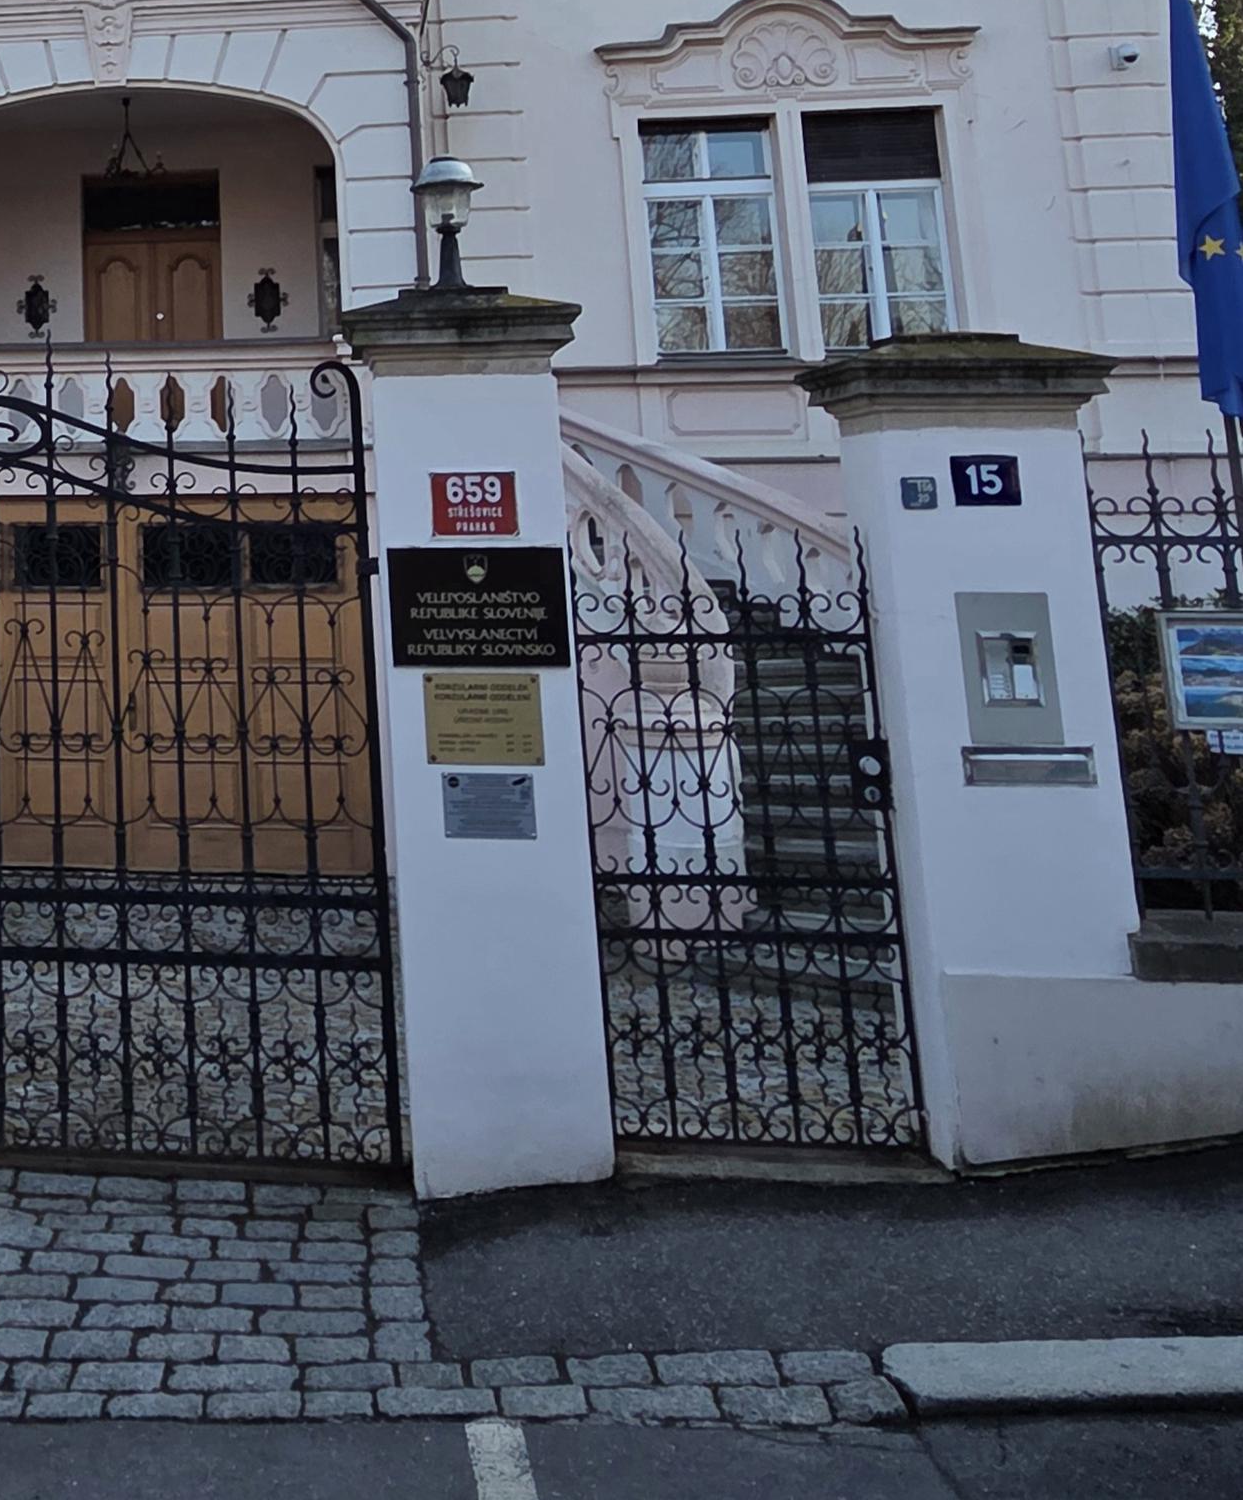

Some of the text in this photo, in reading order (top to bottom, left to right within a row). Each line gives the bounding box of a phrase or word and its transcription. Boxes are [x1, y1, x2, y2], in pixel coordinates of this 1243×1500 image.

[965, 464, 1003, 495] 15
[446, 475, 502, 504] 659
[447, 505, 503, 518] STŘEŠOVICE
[456, 521, 487, 532] PRAHA
[416, 590, 541, 604] VELEPOSLANIŠTVO
[410, 607, 548, 621] REPUBLIKE SLOVENIJE
[423, 626, 539, 641] VELVYSLANECTVÍ
[407, 643, 556, 656] REPUBLIKY SLOVINSKO
